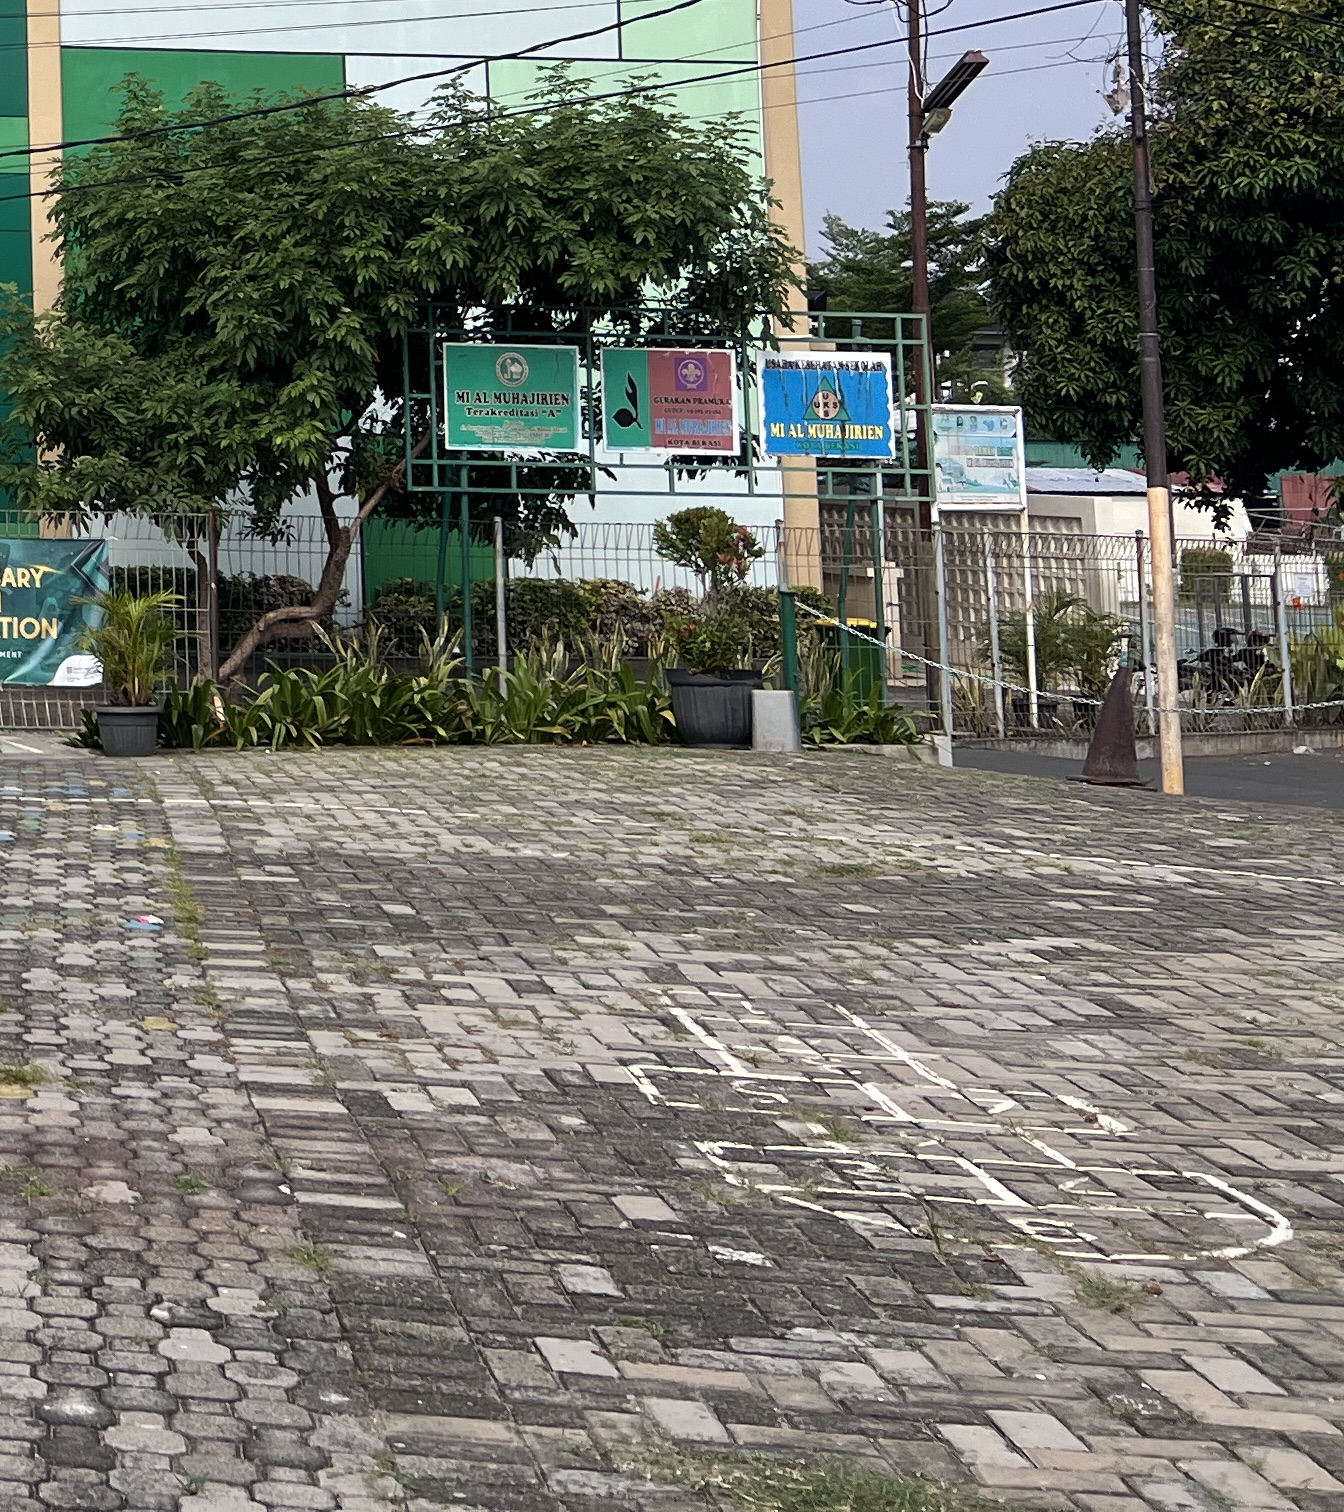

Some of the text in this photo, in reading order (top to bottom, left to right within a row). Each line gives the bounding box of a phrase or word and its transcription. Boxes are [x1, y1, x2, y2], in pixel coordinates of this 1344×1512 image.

[456, 391, 570, 406] MI AL MUHAJIRIEN
[654, 396, 691, 404] GERAKAN
[466, 407, 539, 417] Terakreditasi
[771, 423, 884, 440] MI AL MUHAJIRIEN
